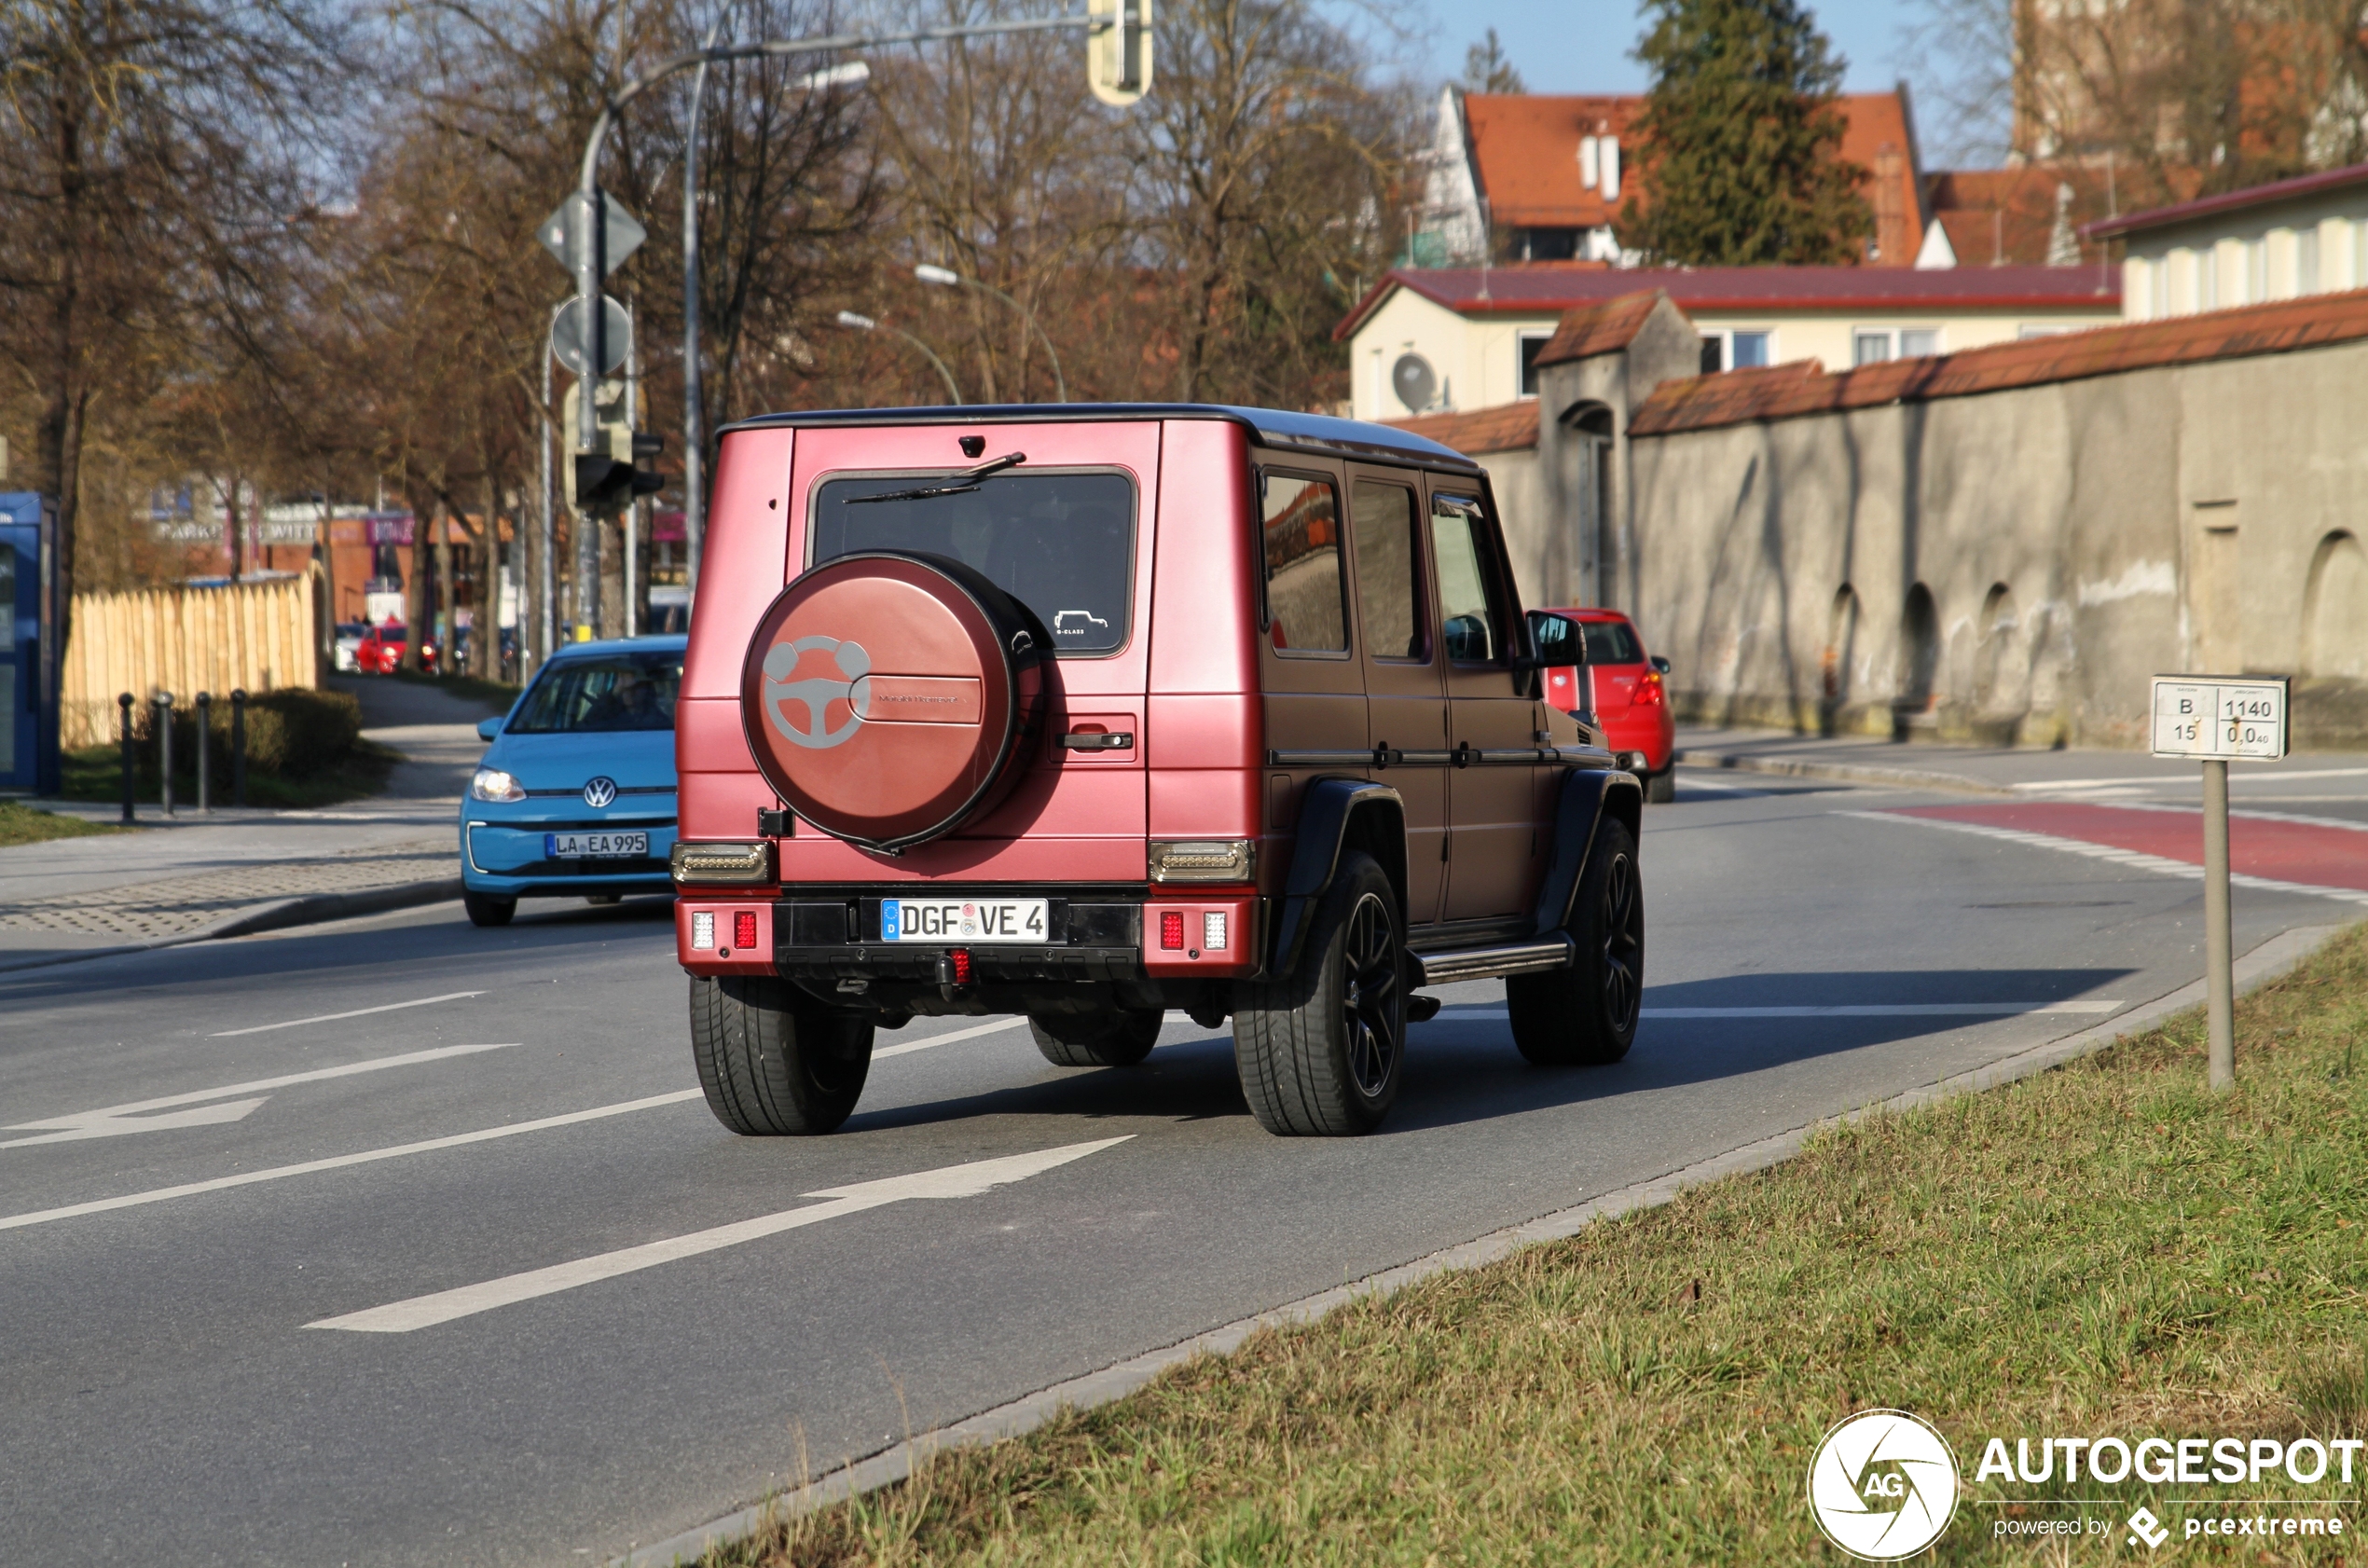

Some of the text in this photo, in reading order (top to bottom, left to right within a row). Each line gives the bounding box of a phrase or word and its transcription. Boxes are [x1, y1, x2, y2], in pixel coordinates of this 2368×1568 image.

[2180, 698, 2194, 714] B
[2225, 700, 2272, 717] 1140
[2174, 724, 2197, 740] 15
[557, 835, 645, 853] LA EA 995
[902, 905, 1043, 935] DGF VE 4
[888, 924, 896, 933] D
